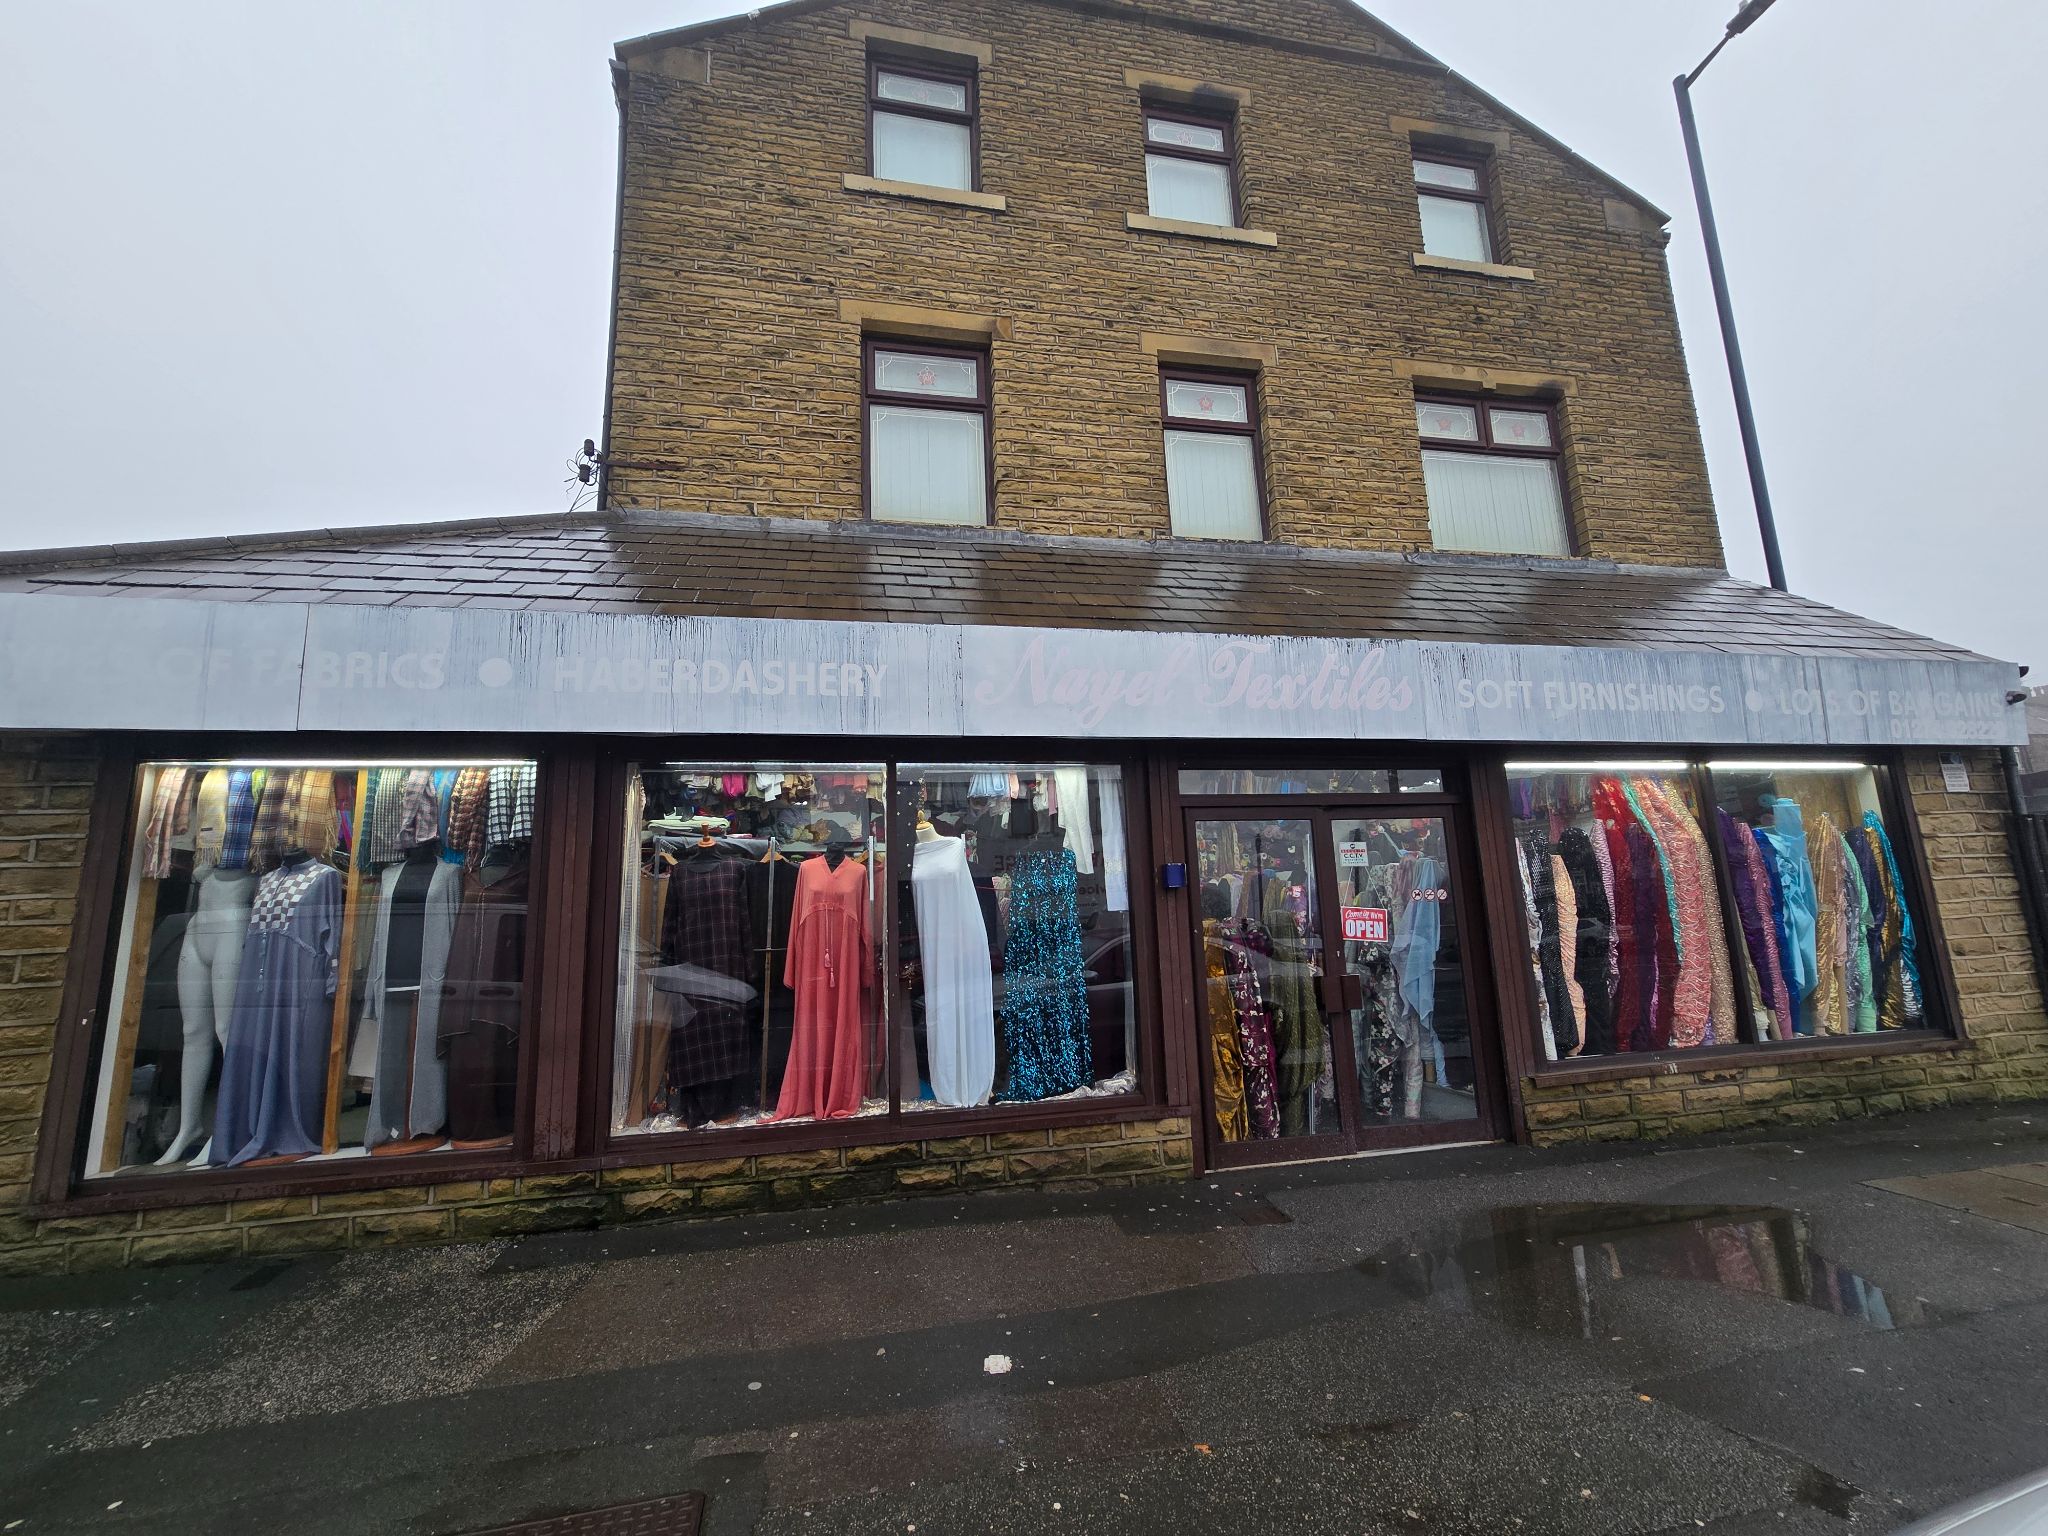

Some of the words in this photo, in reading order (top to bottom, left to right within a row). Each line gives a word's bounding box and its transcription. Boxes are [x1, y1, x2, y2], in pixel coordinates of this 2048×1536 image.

[156, 647, 233, 690] OF
[251, 648, 446, 692] FABRICS
[553, 656, 889, 698] HABERDASHERY
[973, 633, 1196, 728] Nayel
[1197, 639, 1415, 712] Textiles
[1457, 678, 1533, 712] SOFT
[1543, 680, 1726, 715] FURNISHINGS
[1780, 689, 1841, 716] LOTS
[1849, 688, 1882, 717] OF
[1888, 689, 2003, 718] BAGAINS
[1345, 919, 1384, 939] OPEN
